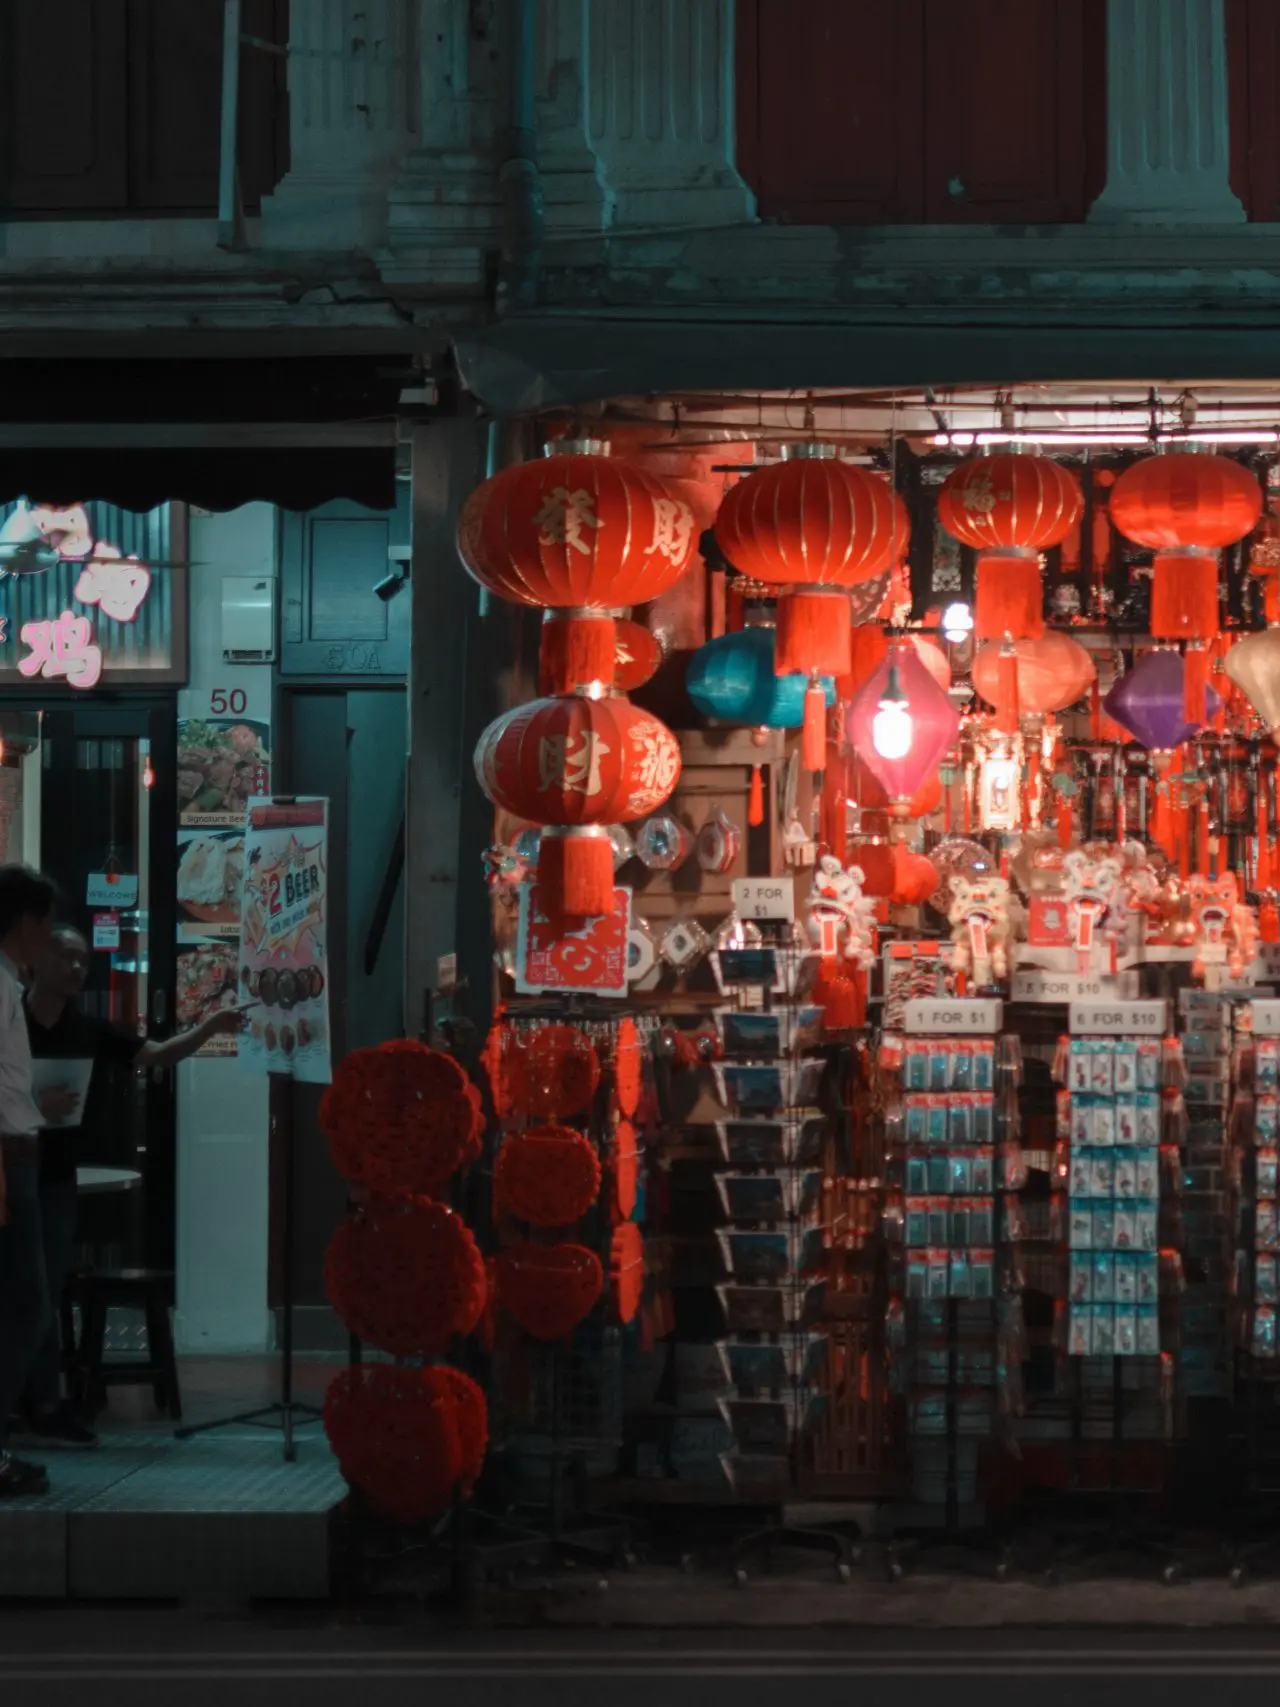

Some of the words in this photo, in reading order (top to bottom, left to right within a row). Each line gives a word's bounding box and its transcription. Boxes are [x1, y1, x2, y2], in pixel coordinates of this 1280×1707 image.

[18, 610, 101, 688] 鸡
[210, 688, 247, 714] 50
[185, 815, 227, 825] Signature
[229, 815, 247, 824] Bee
[284, 864, 320, 908] BEER
[88, 890, 137, 900] WELCOME
[743, 887, 751, 899] 2
[757, 888, 783, 900] FOR
[754, 903, 768, 917] $1
[1041, 982, 1070, 994] FOR
[1077, 982, 1101, 995] $10
[917, 1012, 923, 1024] 1
[933, 1012, 963, 1024] FOR
[970, 1012, 986, 1025] $1
[1093, 1013, 1123, 1025] FOR
[1132, 1012, 1156, 1026] $10
[1265, 1012, 1272, 1025] 1
